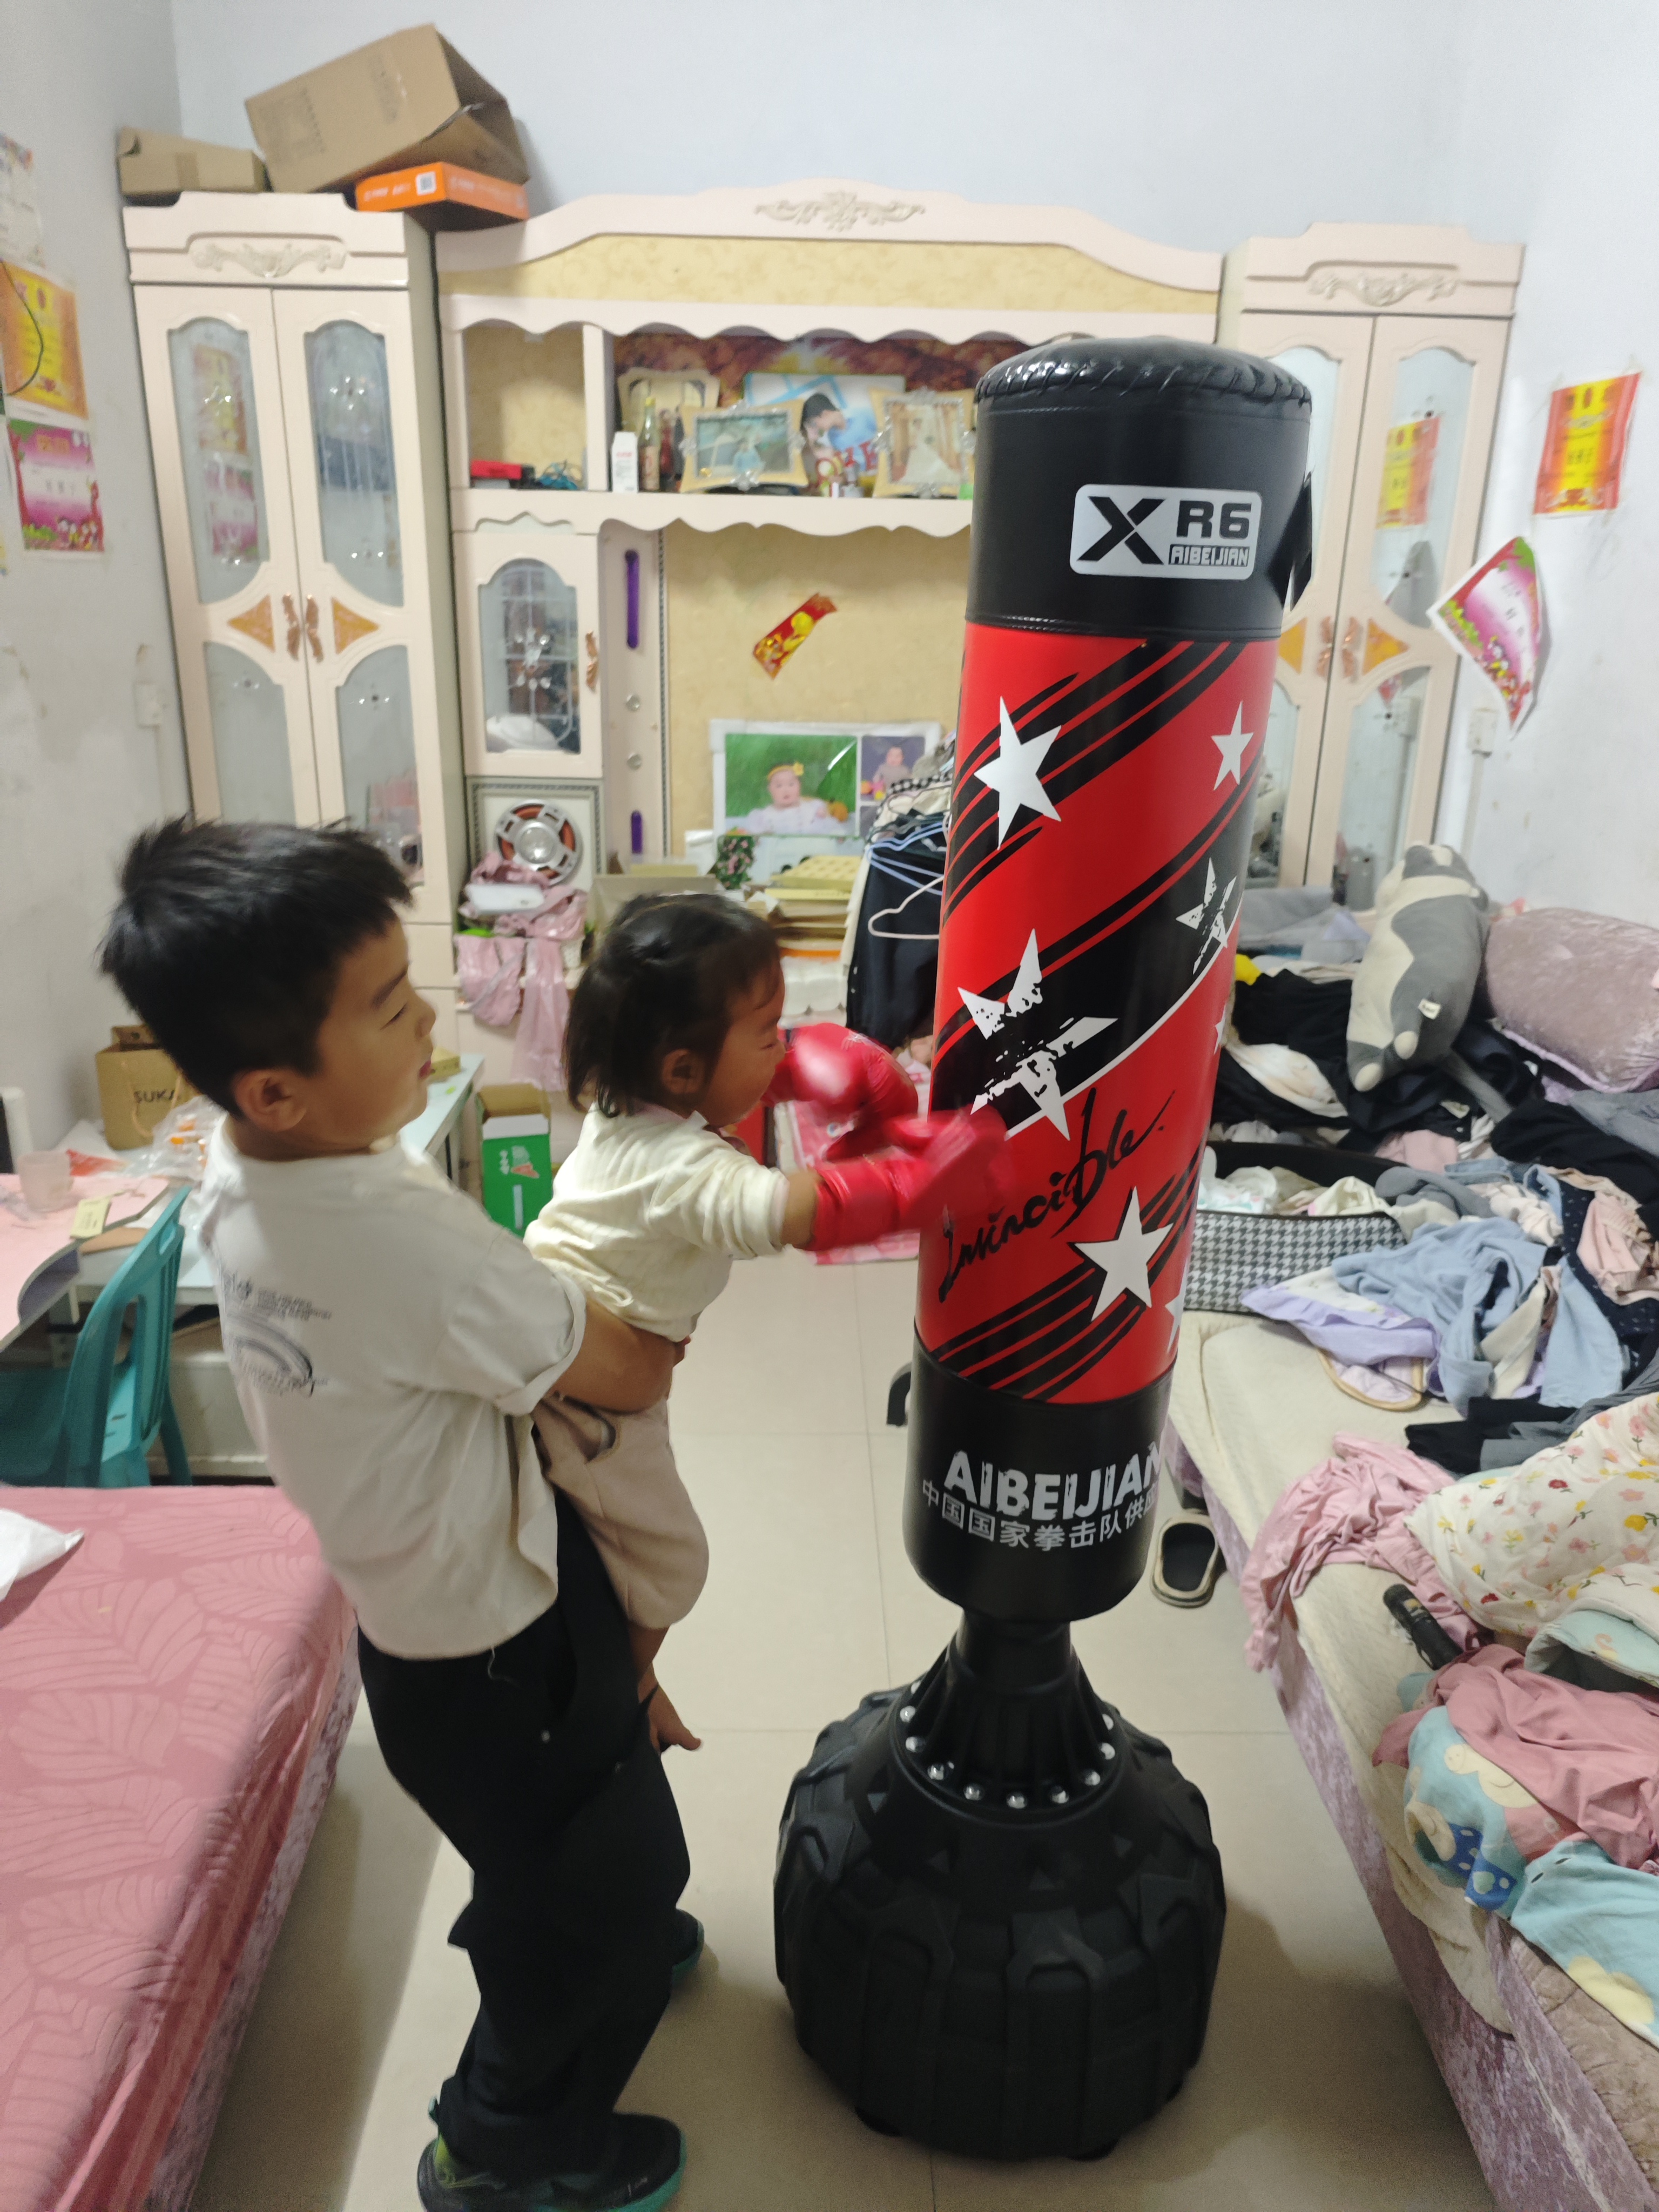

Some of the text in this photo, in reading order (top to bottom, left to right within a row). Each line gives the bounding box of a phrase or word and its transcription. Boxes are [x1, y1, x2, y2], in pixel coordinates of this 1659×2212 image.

[1077, 496, 1252, 564] X R6
[1171, 545, 1249, 568] AIBEIJIAN
